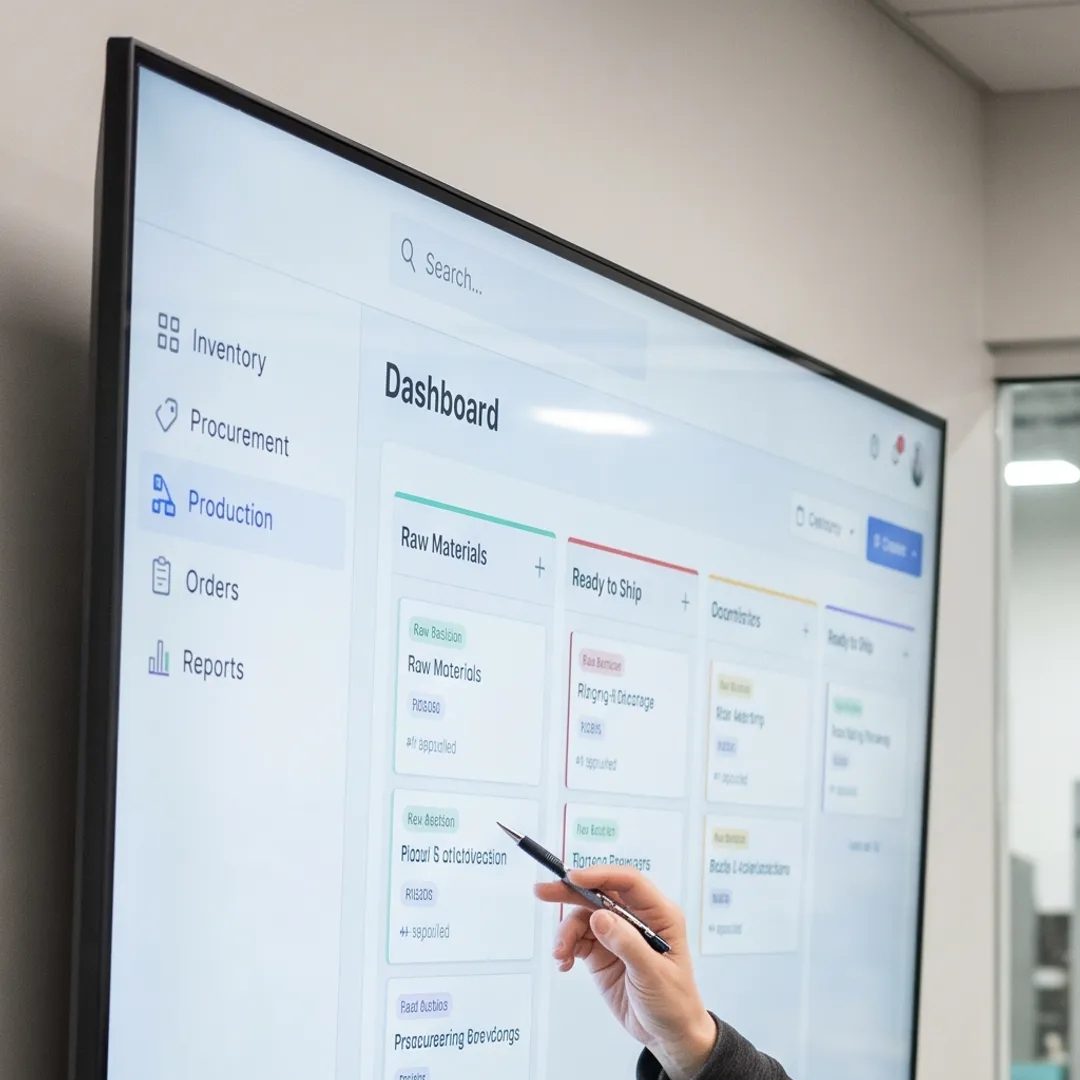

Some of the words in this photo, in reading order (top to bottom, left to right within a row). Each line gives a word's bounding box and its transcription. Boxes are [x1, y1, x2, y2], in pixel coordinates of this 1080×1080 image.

[425, 251, 483, 296] Search...
[192, 328, 267, 377] Inventory
[384, 360, 500, 432] Dashboard
[190, 408, 290, 458] Procurement
[188, 489, 273, 531] Production
[401, 526, 429, 552] Raw
[432, 533, 488, 566] Materials
[185, 568, 240, 602] Orders
[572, 567, 604, 597] Ready
[607, 576, 617, 596] to
[620, 579, 642, 606] Ship
[183, 648, 245, 682] Reports
[408, 655, 431, 677] Raw
